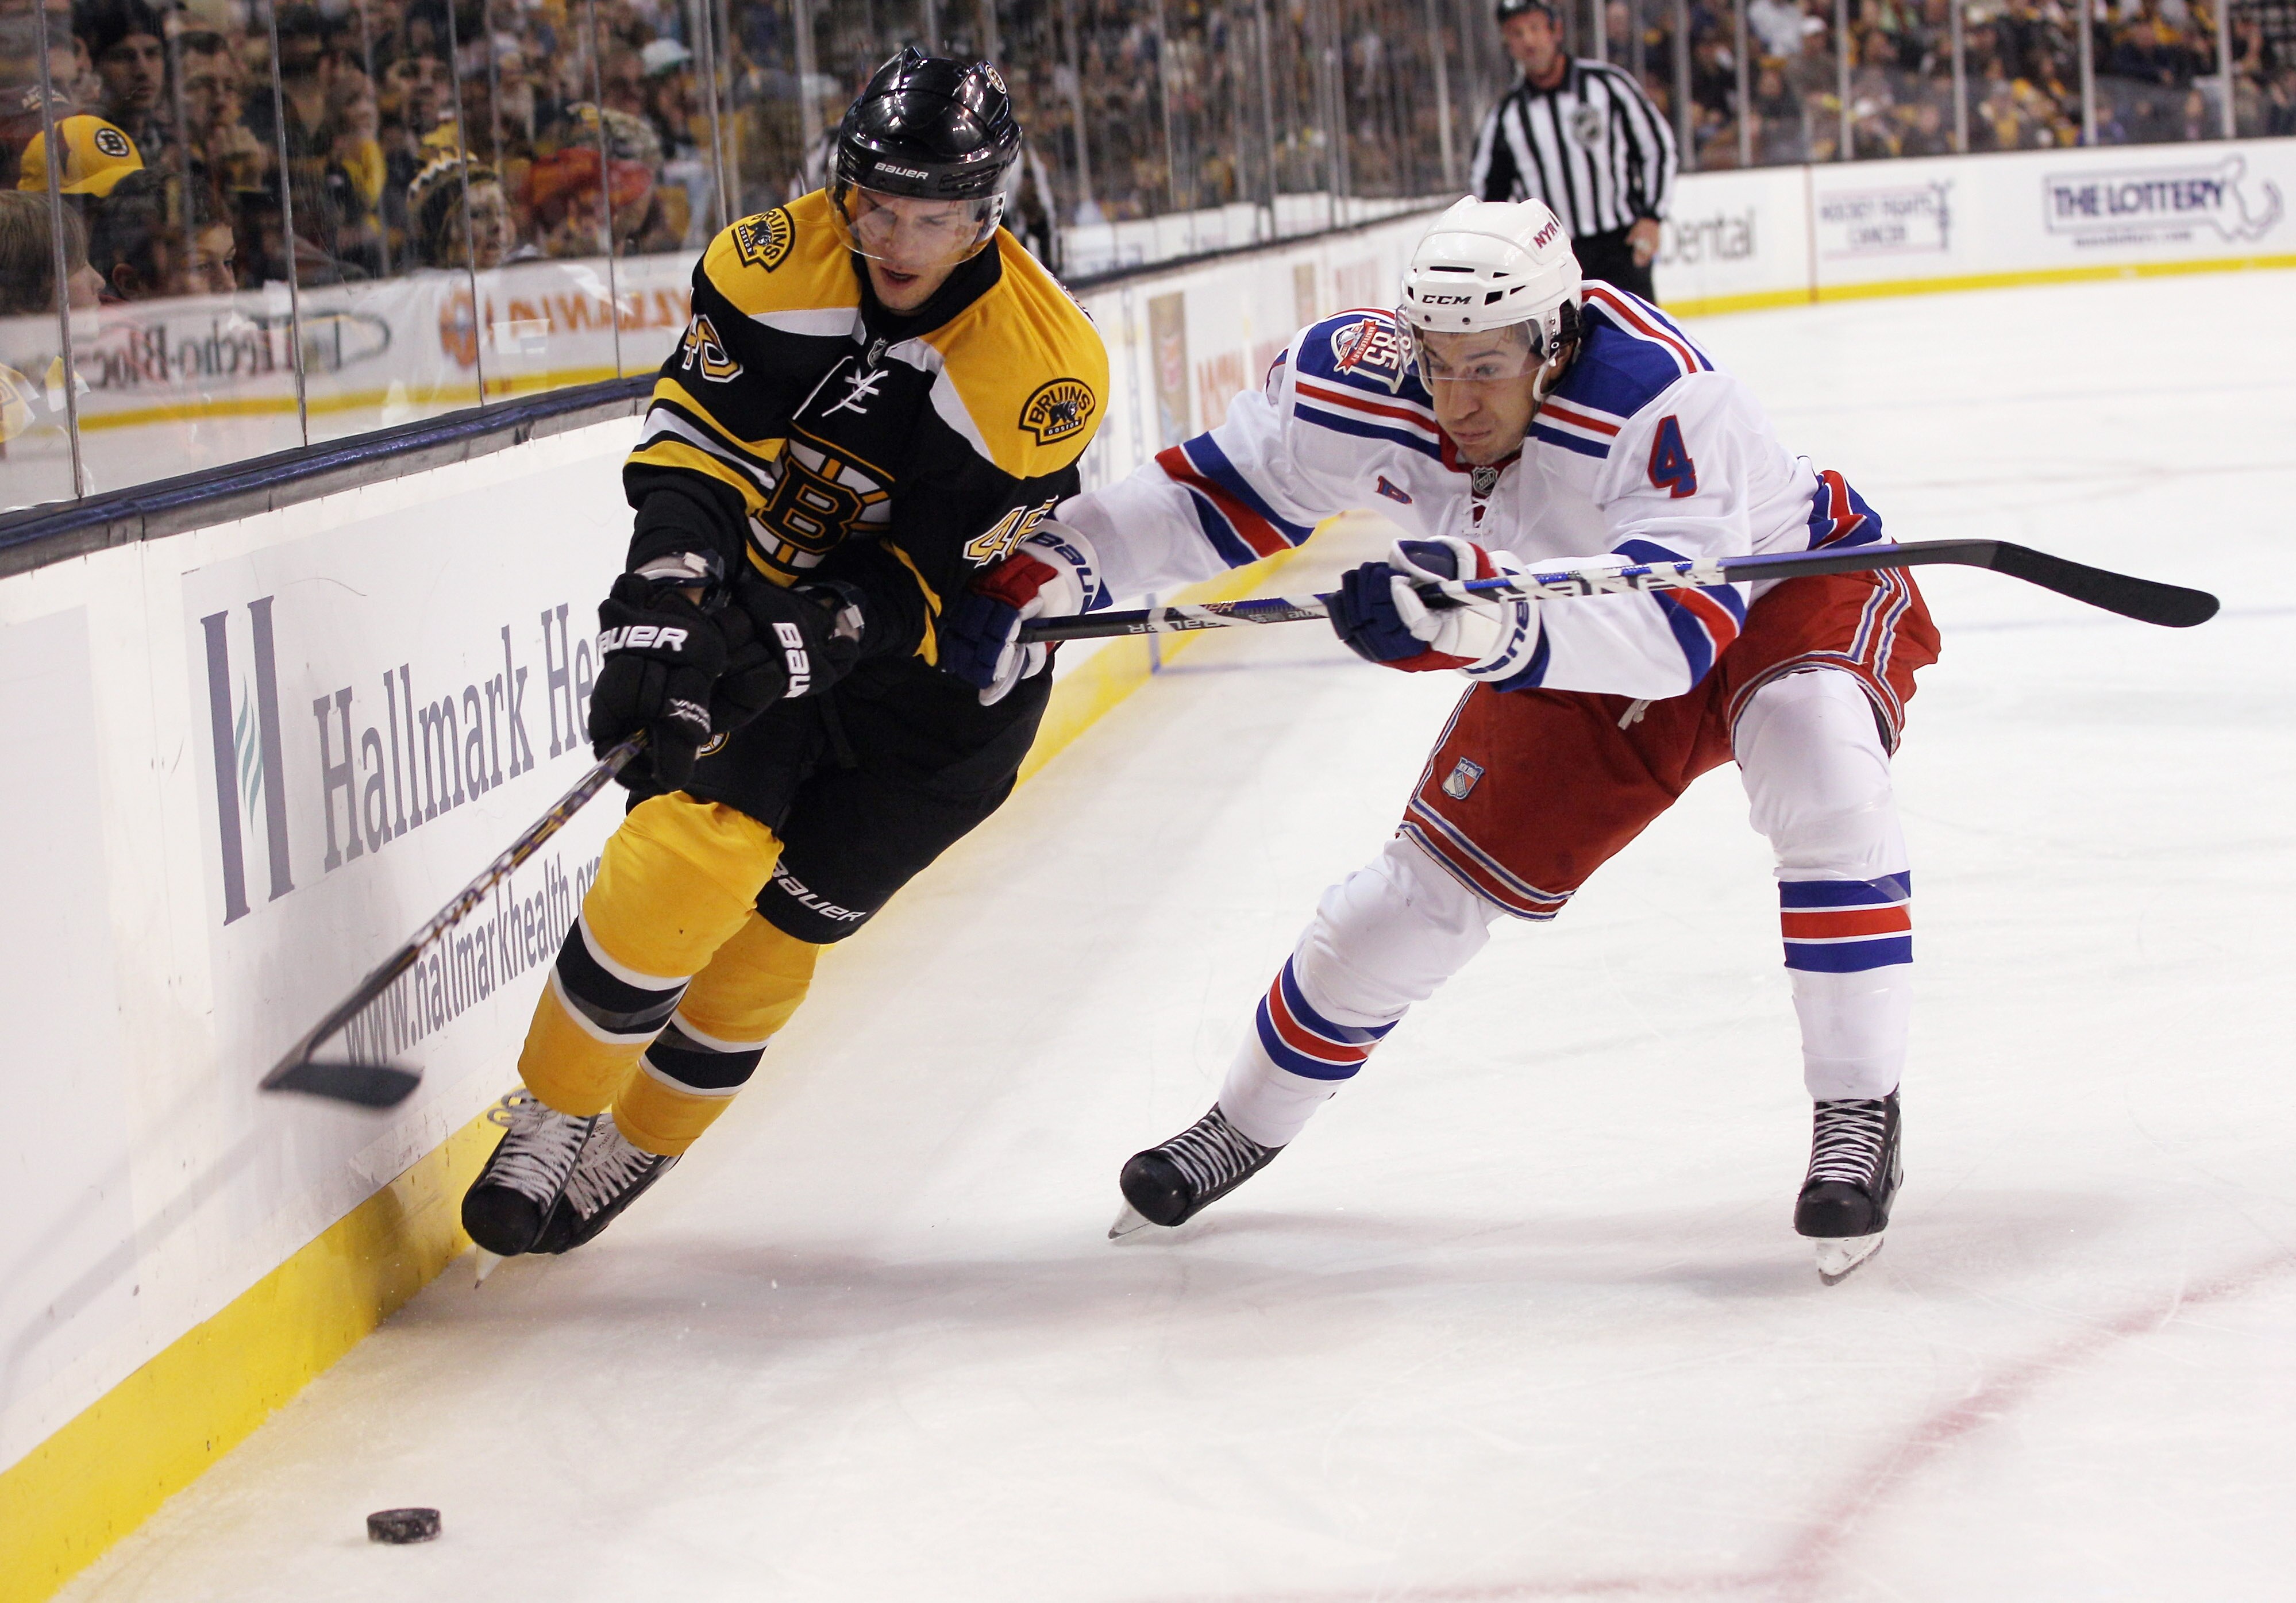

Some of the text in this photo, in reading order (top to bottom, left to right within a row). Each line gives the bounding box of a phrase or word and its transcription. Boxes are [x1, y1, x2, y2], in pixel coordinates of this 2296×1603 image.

[2054, 179, 2224, 217] THE LOTTERY
[1422, 294, 1472, 305] CCM
[1028, 386, 1090, 425] BRUINS
[1048, 421, 1079, 435] BOSTON
[1647, 414, 1697, 499] 4
[757, 456, 862, 553] B
[313, 624, 534, 873] Hallmark
